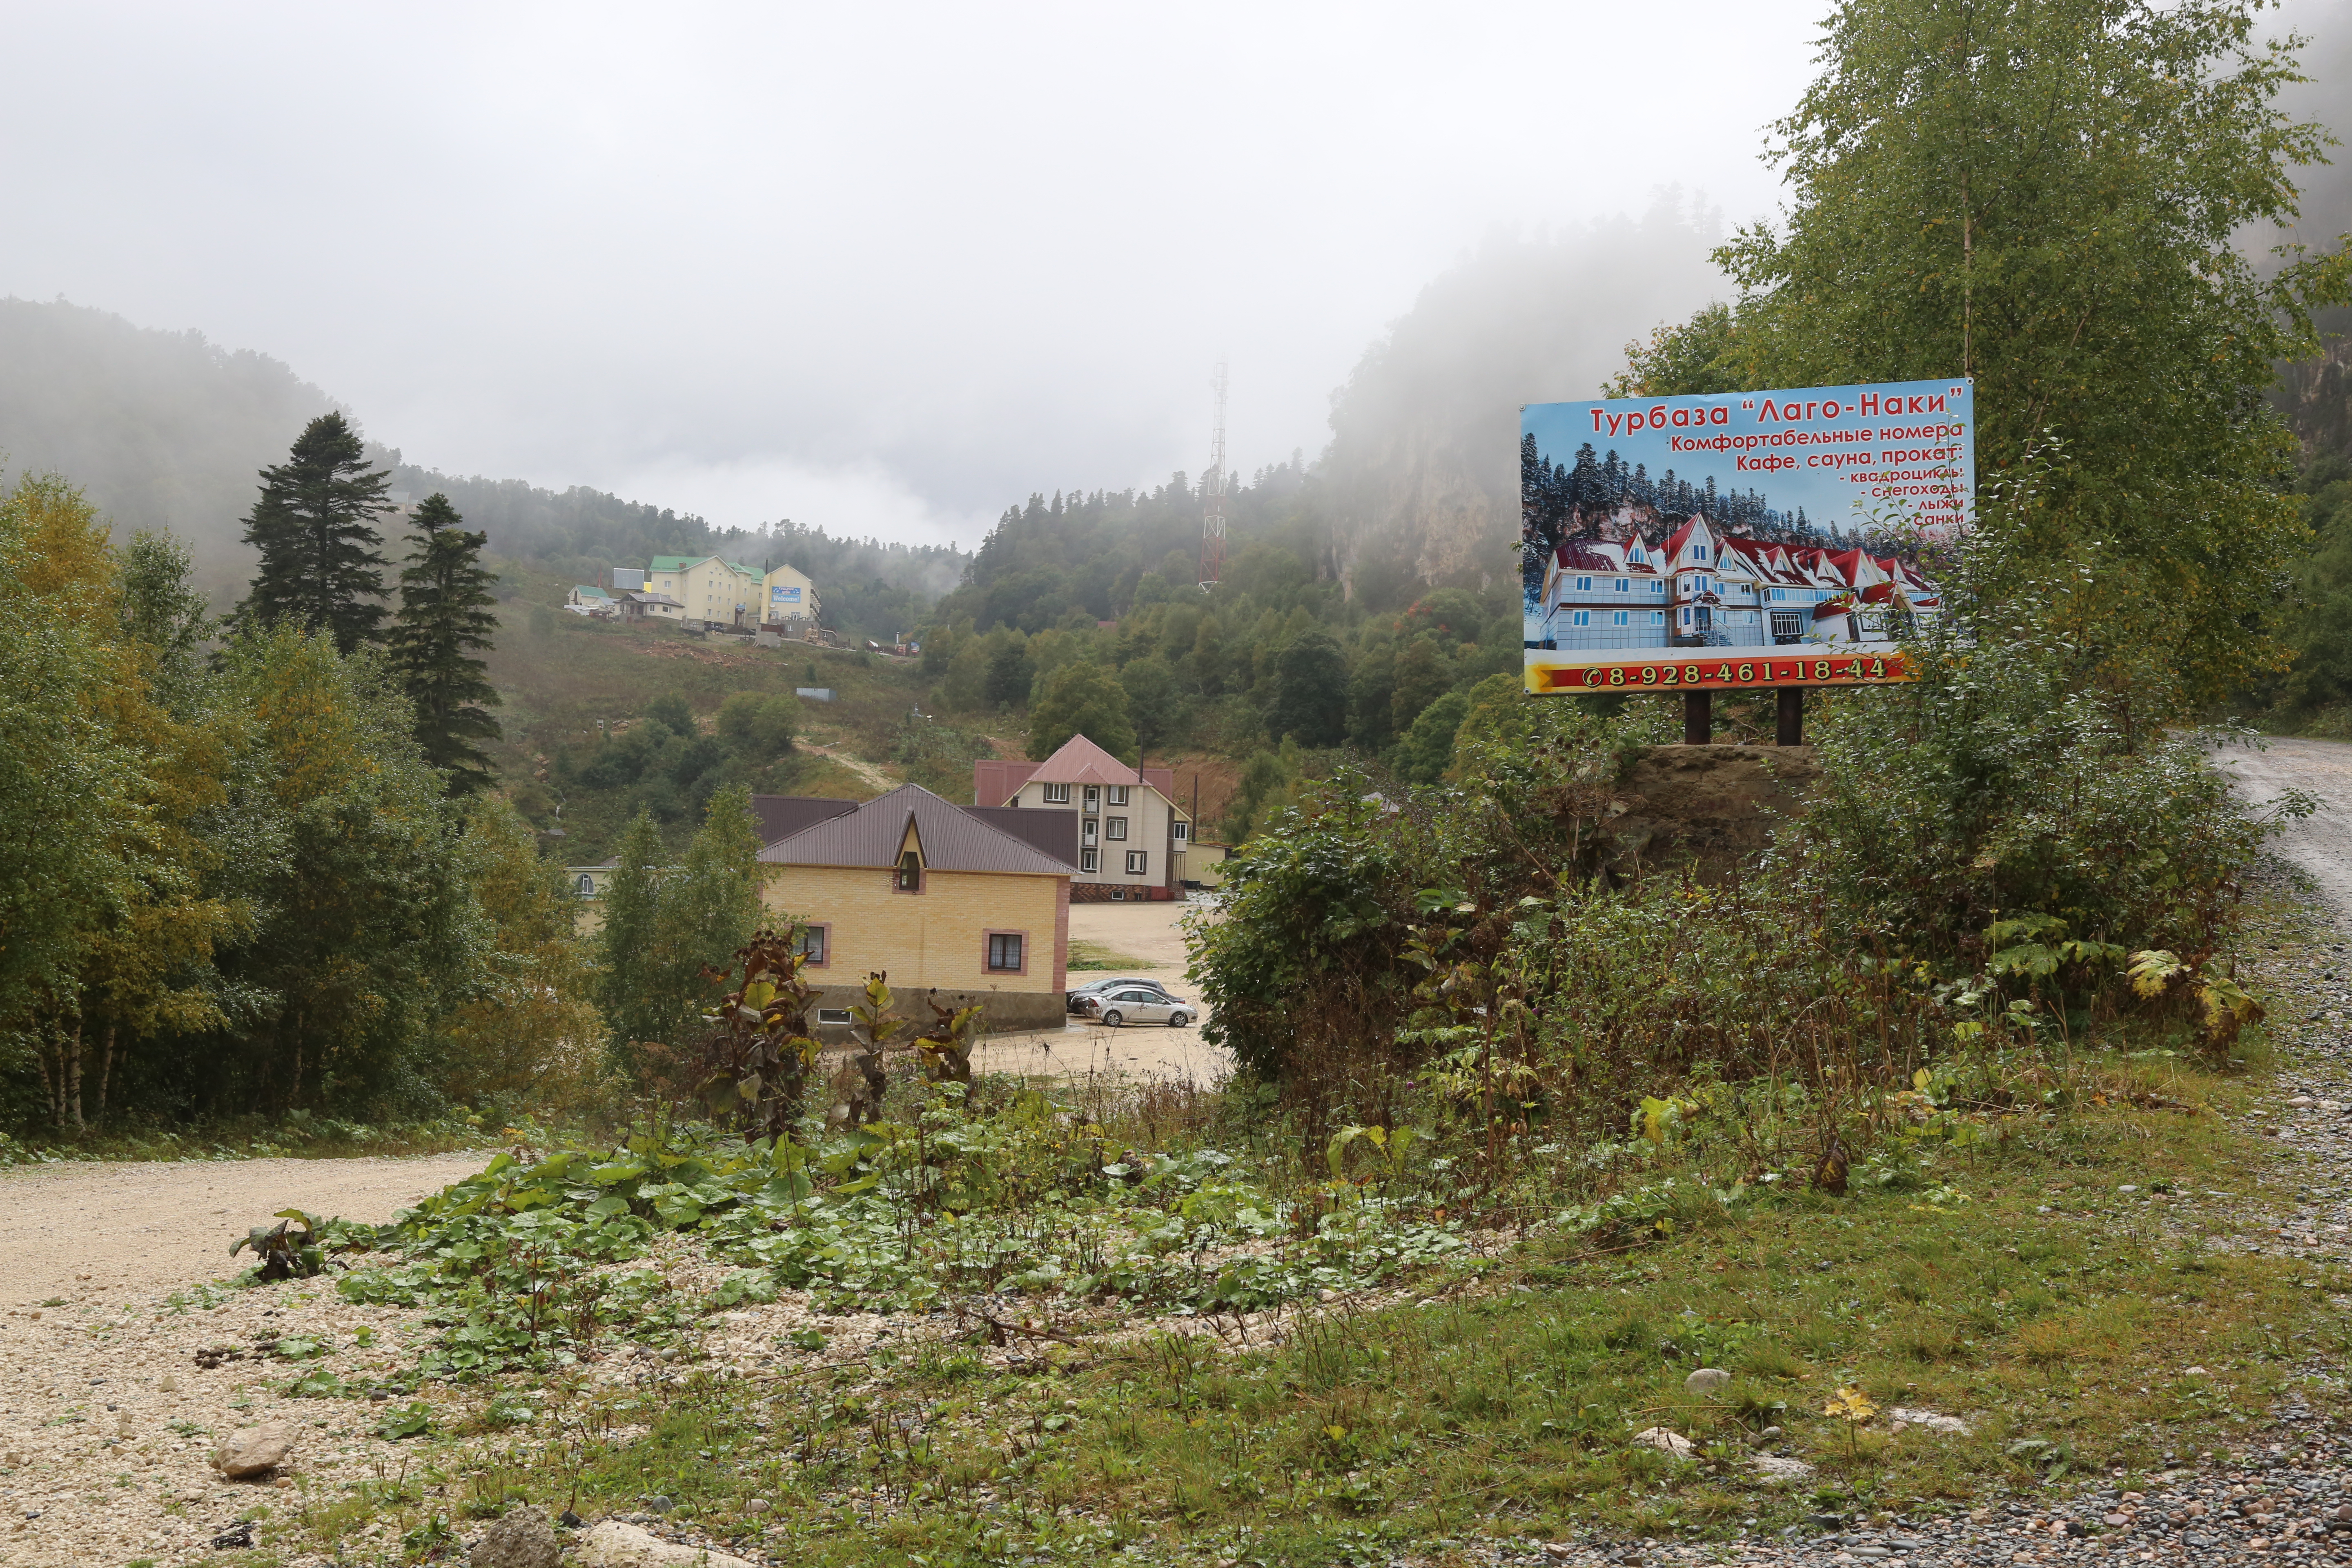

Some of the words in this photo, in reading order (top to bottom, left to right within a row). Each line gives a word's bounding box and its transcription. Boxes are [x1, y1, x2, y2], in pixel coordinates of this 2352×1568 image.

[1591, 405, 1728, 436] Турбаза
[1671, 429, 1872, 452] Комфортабельные
[1880, 425, 1962, 441] номера
[1737, 454, 1800, 473] Кафе,
[1808, 452, 1876, 469] сауна,
[1882, 447, 1962, 466] прокат:
[1851, 468, 1963, 483] квадроциклы
[1872, 483, 1963, 497] снегоходы
[1918, 499, 1964, 510] лыжи
[1914, 514, 1964, 526] санки
[1609, 658, 1885, 686] 8-928-461-18-44
